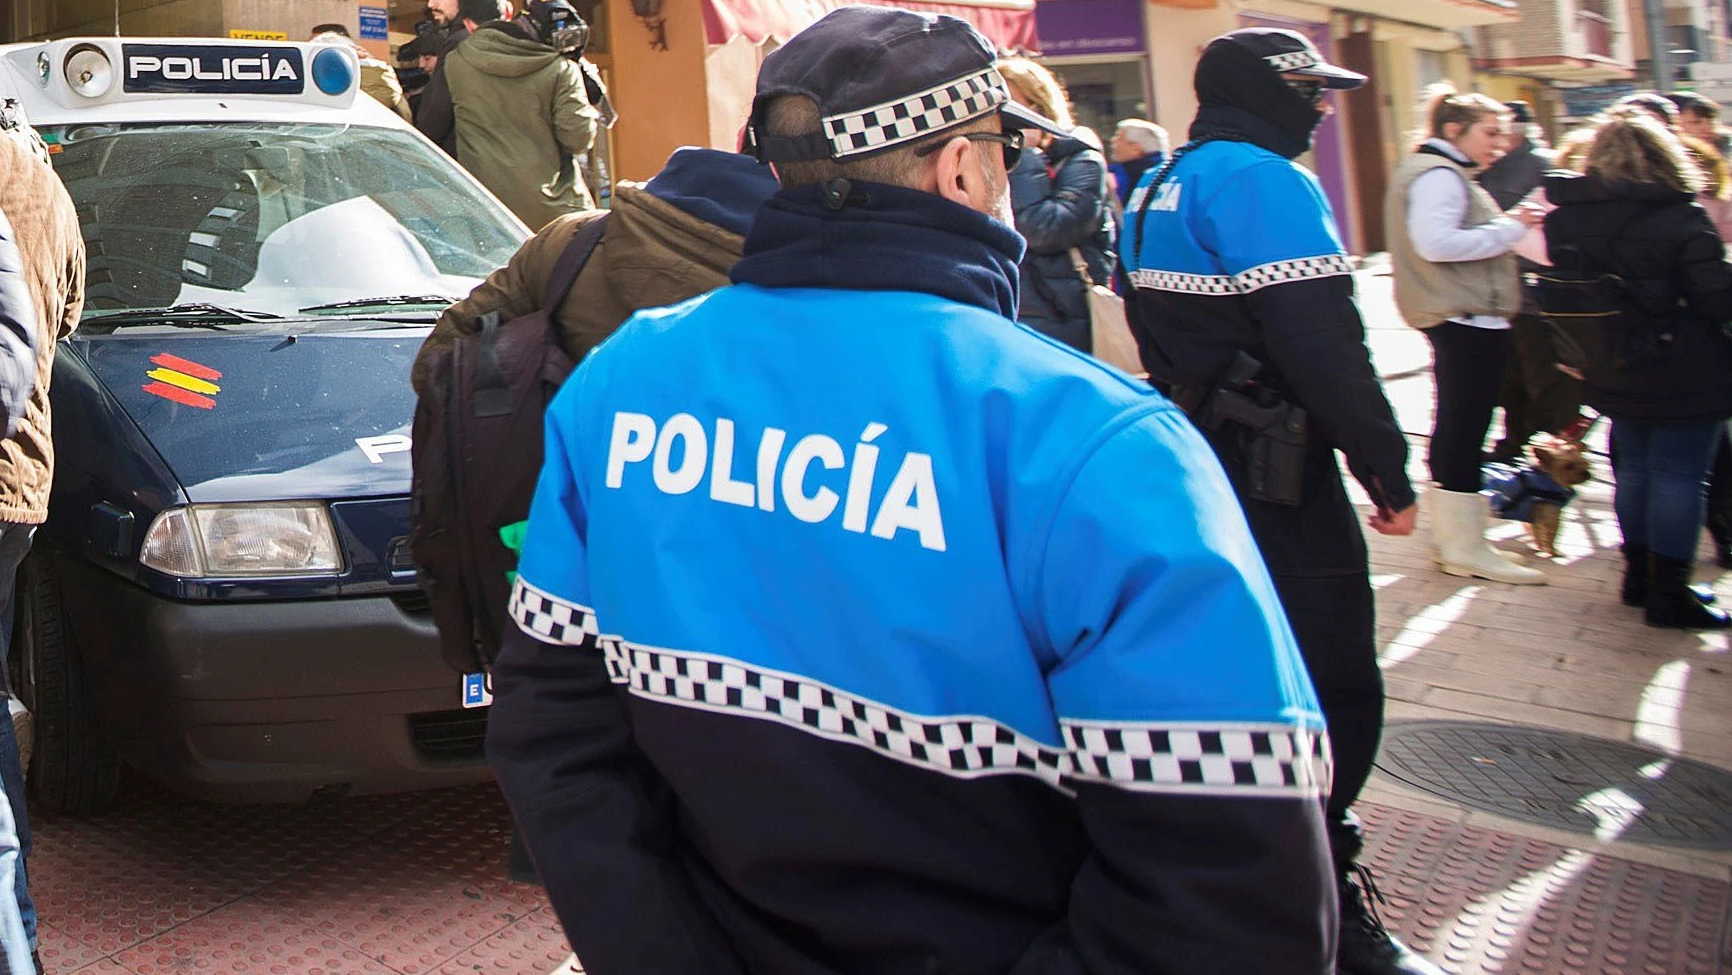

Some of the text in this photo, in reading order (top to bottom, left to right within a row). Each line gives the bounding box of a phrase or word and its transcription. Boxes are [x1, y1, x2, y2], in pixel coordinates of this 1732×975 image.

[128, 53, 298, 81] POLICÍA
[604, 410, 948, 553] POLICÍA
[469, 683, 480, 697] E
